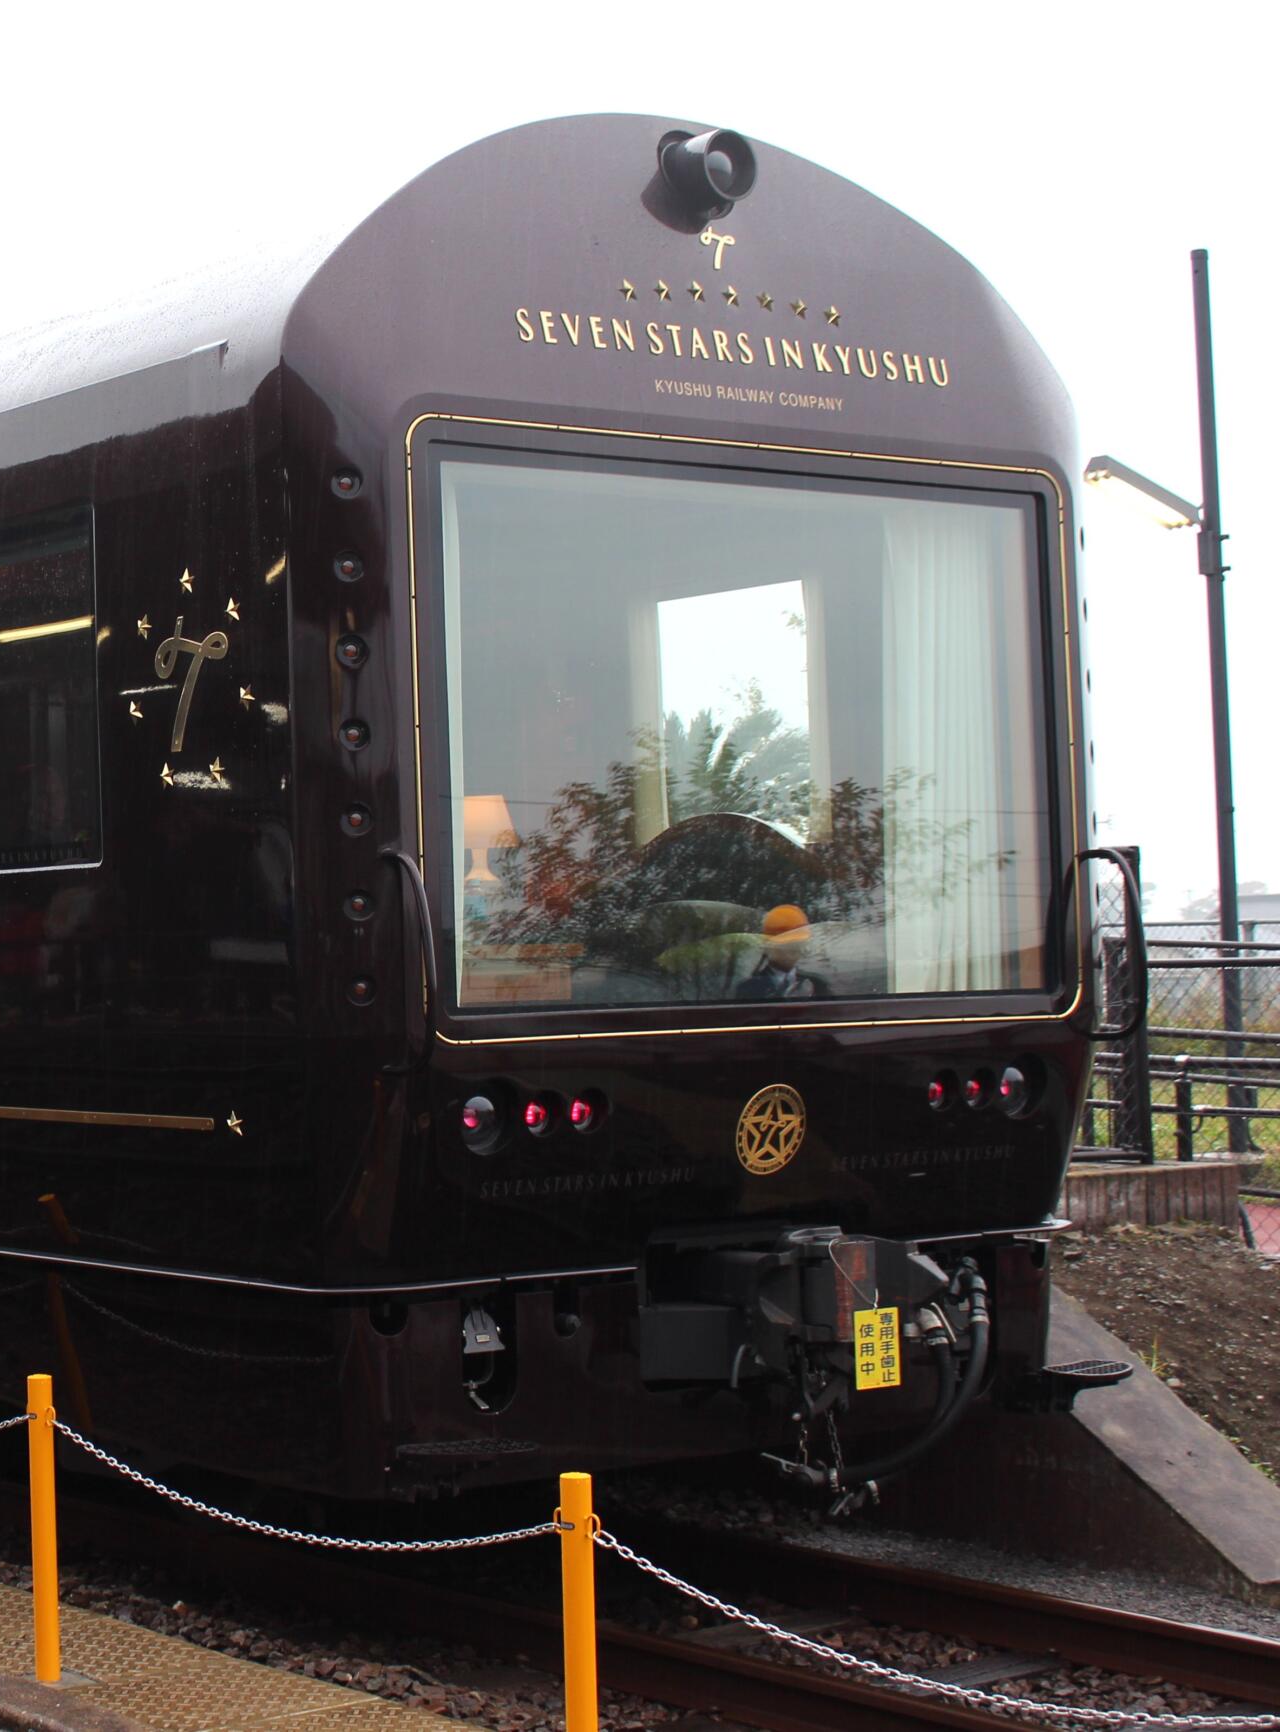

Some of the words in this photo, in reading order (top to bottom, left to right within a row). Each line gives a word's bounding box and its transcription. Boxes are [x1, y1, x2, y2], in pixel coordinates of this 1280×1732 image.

[515, 308, 635, 351] SEVEN
[646, 322, 754, 364] STARS
[764, 336, 804, 369] IN
[812, 343, 949, 387] KYUSHU
[655, 379, 712, 398] KYUSHU
[716, 385, 774, 405] RAILWAY
[778, 392, 845, 411] COMPANY
[480, 1176, 537, 1198] SEVEN
[543, 1174, 595, 1194] STARS
[624, 1167, 696, 1187] KYUSHU
[859, 1323, 875, 1375] 使用中
